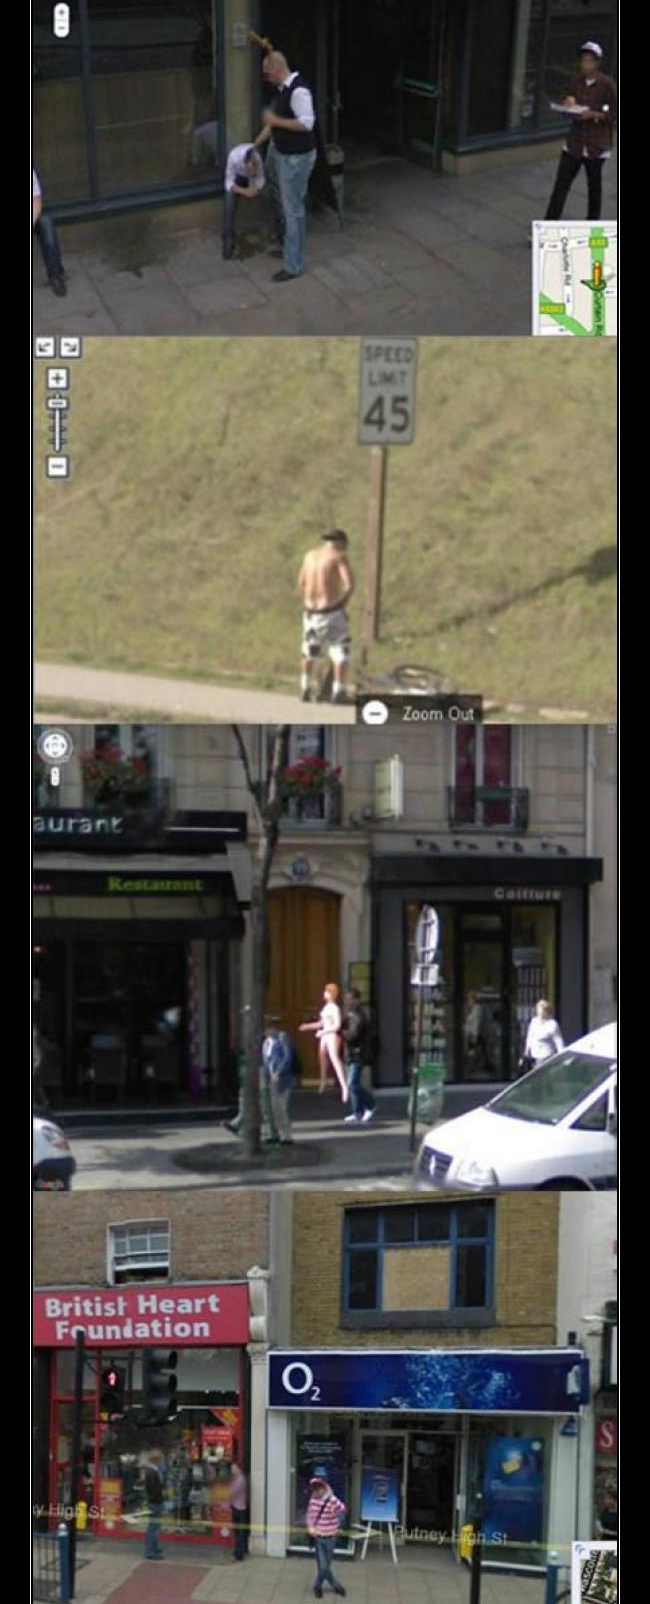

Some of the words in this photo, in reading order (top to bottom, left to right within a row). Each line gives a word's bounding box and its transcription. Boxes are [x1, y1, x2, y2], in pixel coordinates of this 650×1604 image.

[365, 344, 413, 364] SPEED
[368, 369, 407, 387] LIMIT
[363, 394, 411, 433] 45
[107, 876, 205, 892] Restaurant
[494, 886, 561, 900] Coiffure
[137, 1293, 221, 1315] Heart
